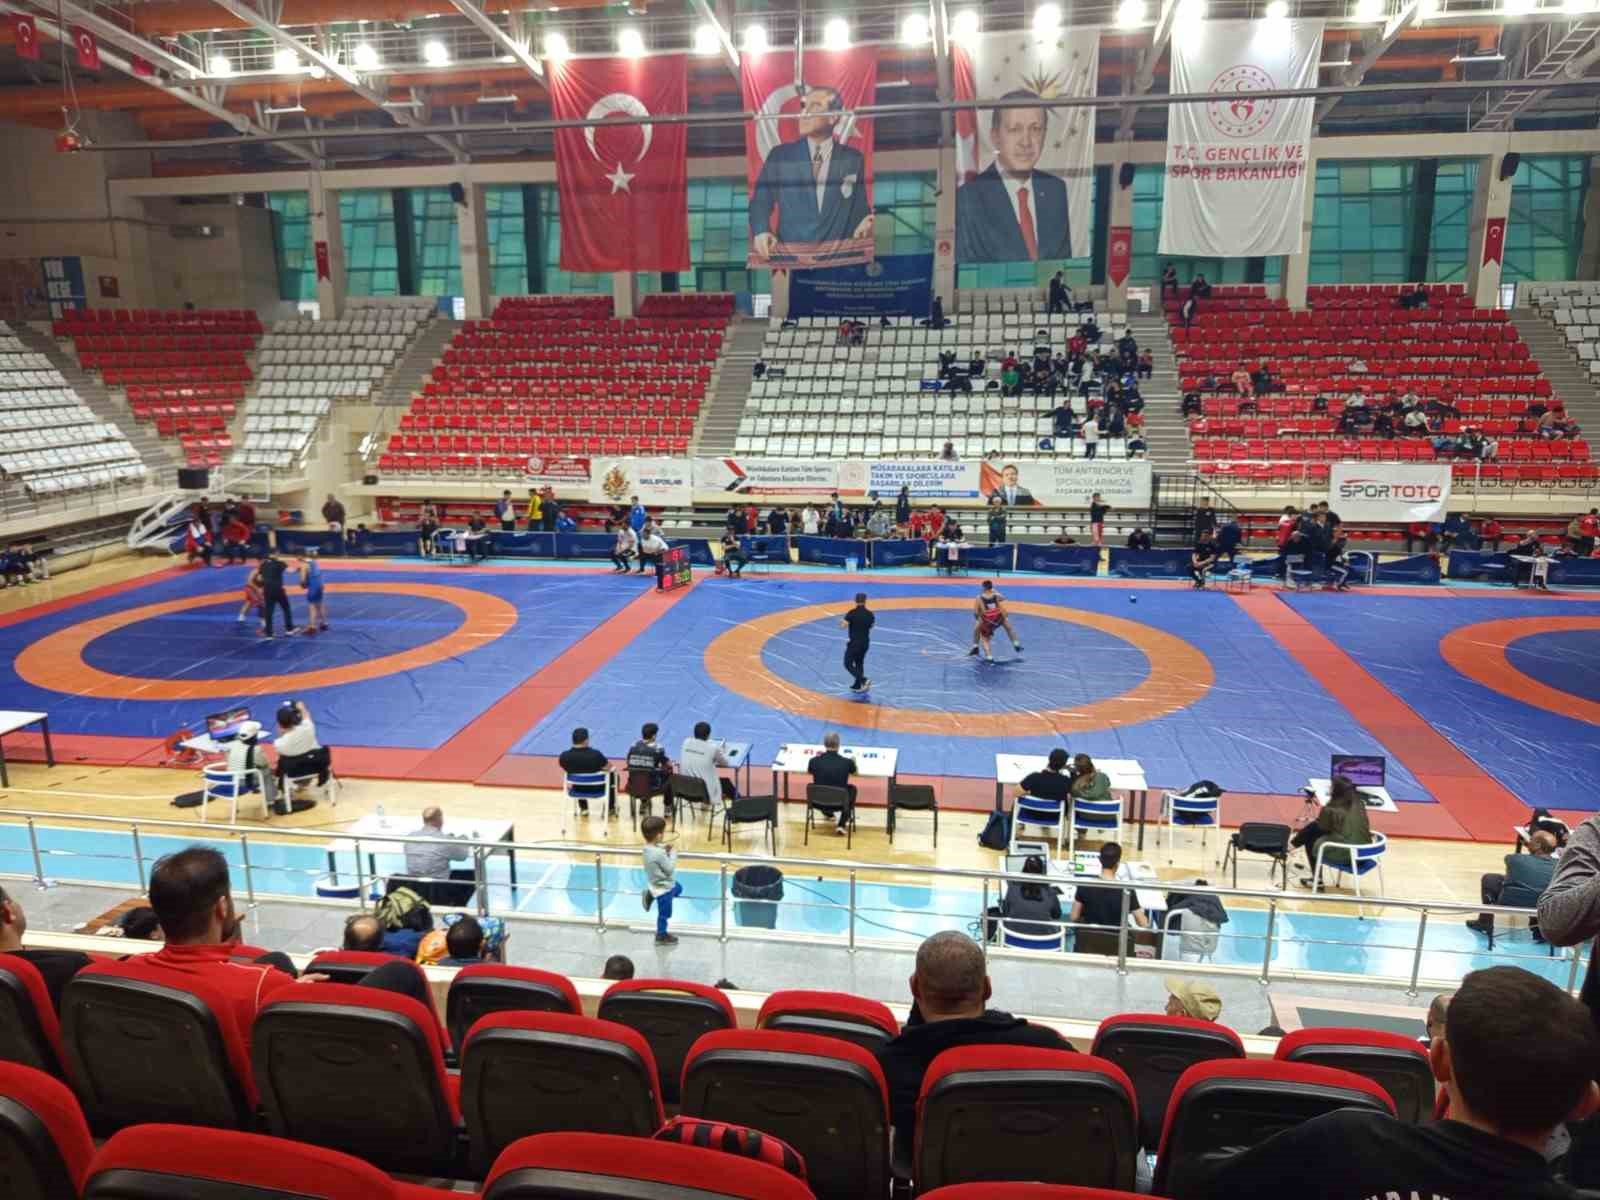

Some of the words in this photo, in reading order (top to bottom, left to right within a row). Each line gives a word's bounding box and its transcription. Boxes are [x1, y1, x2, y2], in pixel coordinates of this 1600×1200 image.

[1172, 145, 1199, 160] T.C.
[1205, 143, 1280, 164] GENÇLİK
[1285, 144, 1303, 159] VE
[1171, 165, 1211, 180] SPOR
